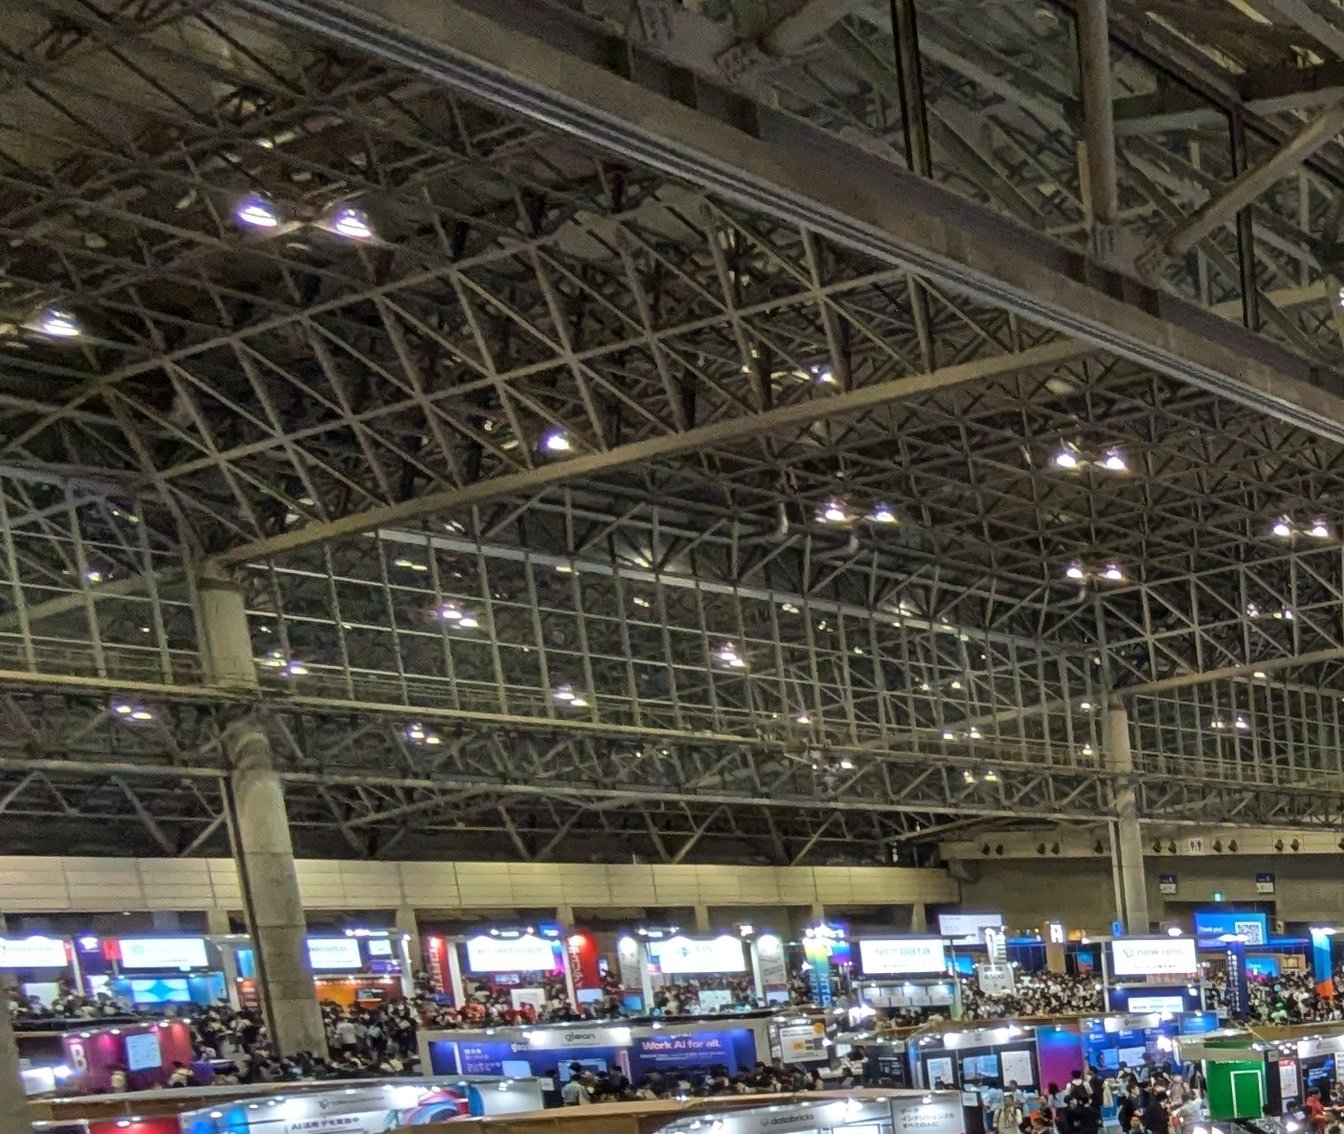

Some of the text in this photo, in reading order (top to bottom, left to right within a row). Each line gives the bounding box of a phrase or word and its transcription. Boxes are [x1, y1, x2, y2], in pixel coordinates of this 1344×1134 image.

[1136, 948, 1158, 956] new
[565, 1032, 596, 1042] glean
[643, 1041, 671, 1051] Work
[688, 1040, 703, 1048] for
[770, 1113, 815, 1126] databricks
